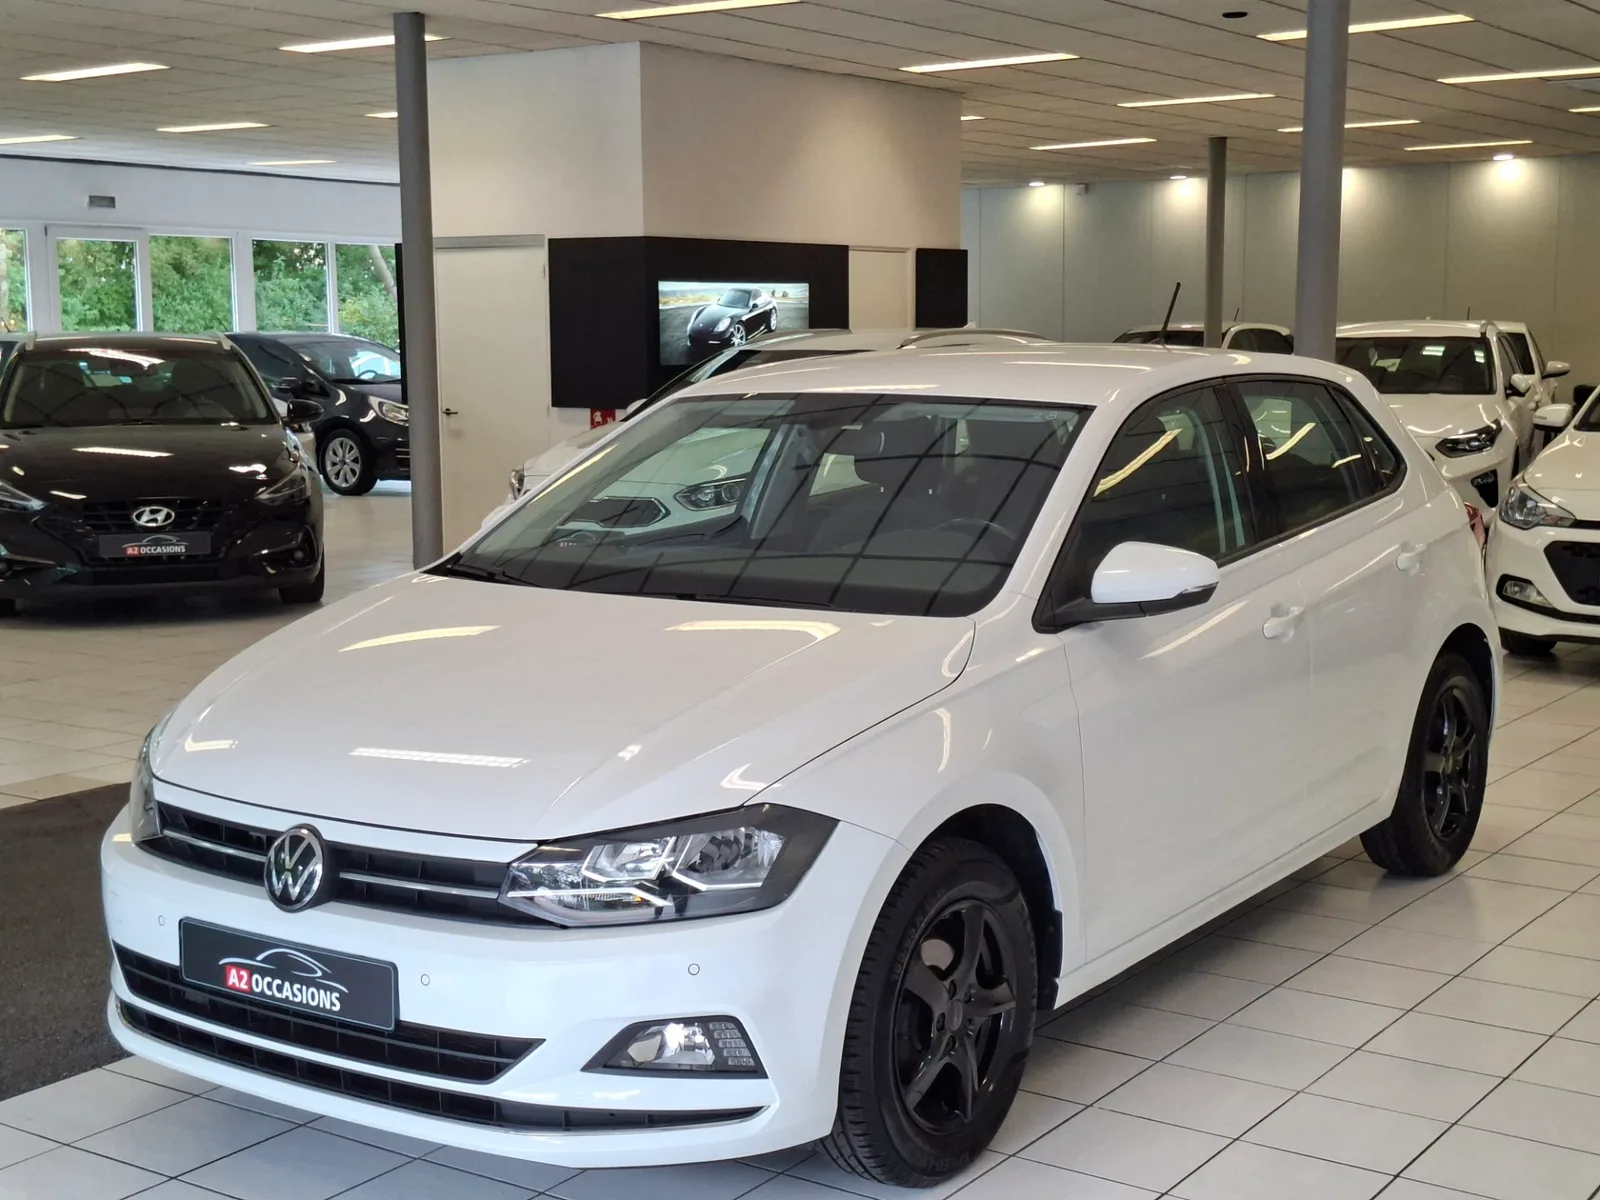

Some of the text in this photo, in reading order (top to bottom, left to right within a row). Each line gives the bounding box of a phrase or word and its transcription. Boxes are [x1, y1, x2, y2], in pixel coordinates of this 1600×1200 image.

[126, 545, 186, 555] A2 OCCASIONS
[227, 968, 341, 1012] A2 OCCASIONS
